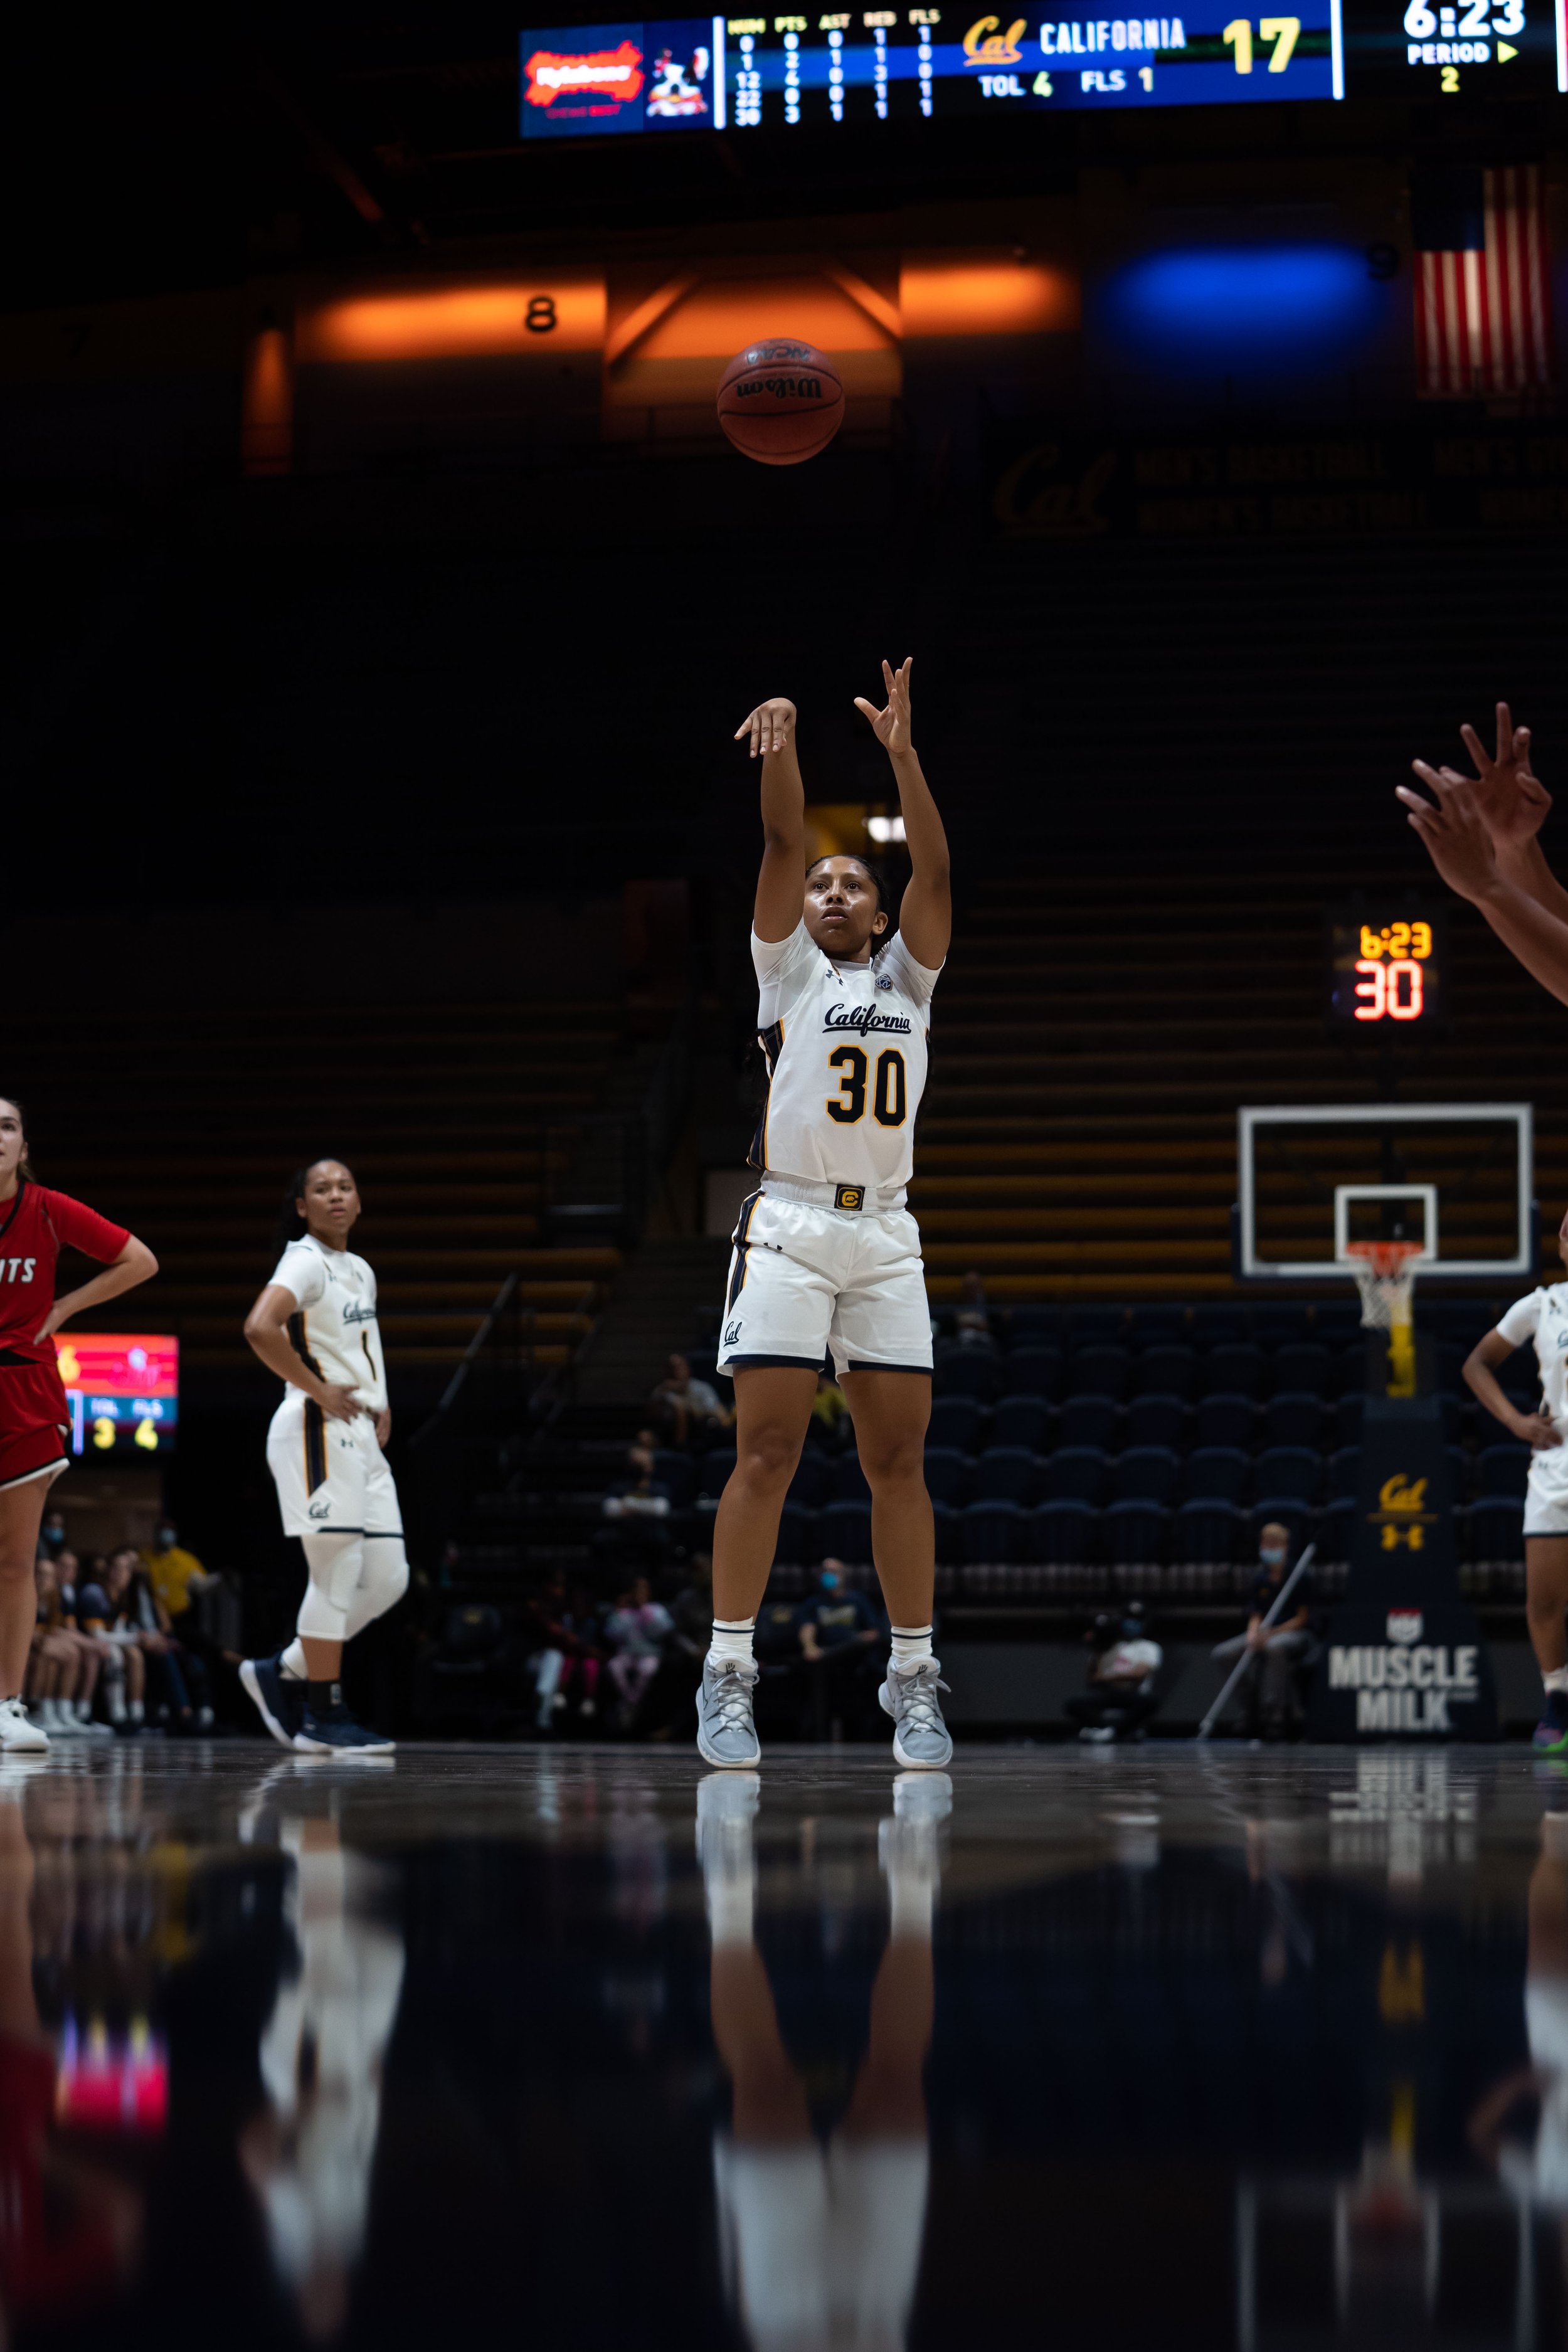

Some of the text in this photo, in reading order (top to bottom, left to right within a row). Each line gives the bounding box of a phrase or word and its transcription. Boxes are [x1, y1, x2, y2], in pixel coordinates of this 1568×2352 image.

[775, 16, 808, 33] PTS
[818, 13, 852, 30] AST
[909, 9, 941, 25] FLS
[874, 27, 887, 46] 1
[918, 24, 931, 43] 1
[1404, 0, 1525, 38] 6:23
[963, 15, 1187, 67] Cal CALIFORNIA
[1223, 16, 1301, 75] 17
[1407, 41, 1491, 65] PERIOD
[741, 53, 753, 72] 1
[830, 48, 842, 66] 1
[874, 45, 886, 64] 1
[874, 82, 887, 100] 1
[919, 79, 933, 98] 1
[978, 74, 1027, 98] TOL
[1080, 66, 1154, 92] FLS 1
[1440, 65, 1460, 93] 2
[830, 102, 844, 122] 1
[874, 100, 888, 119] 1
[919, 97, 933, 117] 1
[526, 295, 558, 332] 8
[736, 378, 823, 400] Wilson
[992, 443, 1118, 539] Cal
[1360, 921, 1432, 960] 6:23
[1354, 958, 1423, 1021] 30
[822, 1003, 912, 1037] California
[825, 1044, 908, 1128] 30
[723, 1321, 744, 1348] Cal
[93, 1416, 116, 1450] 3
[1379, 1473, 1429, 1512] Cal
[1328, 1645, 1479, 1689] MUSCLE
[1355, 1689, 1452, 1733] MILK
